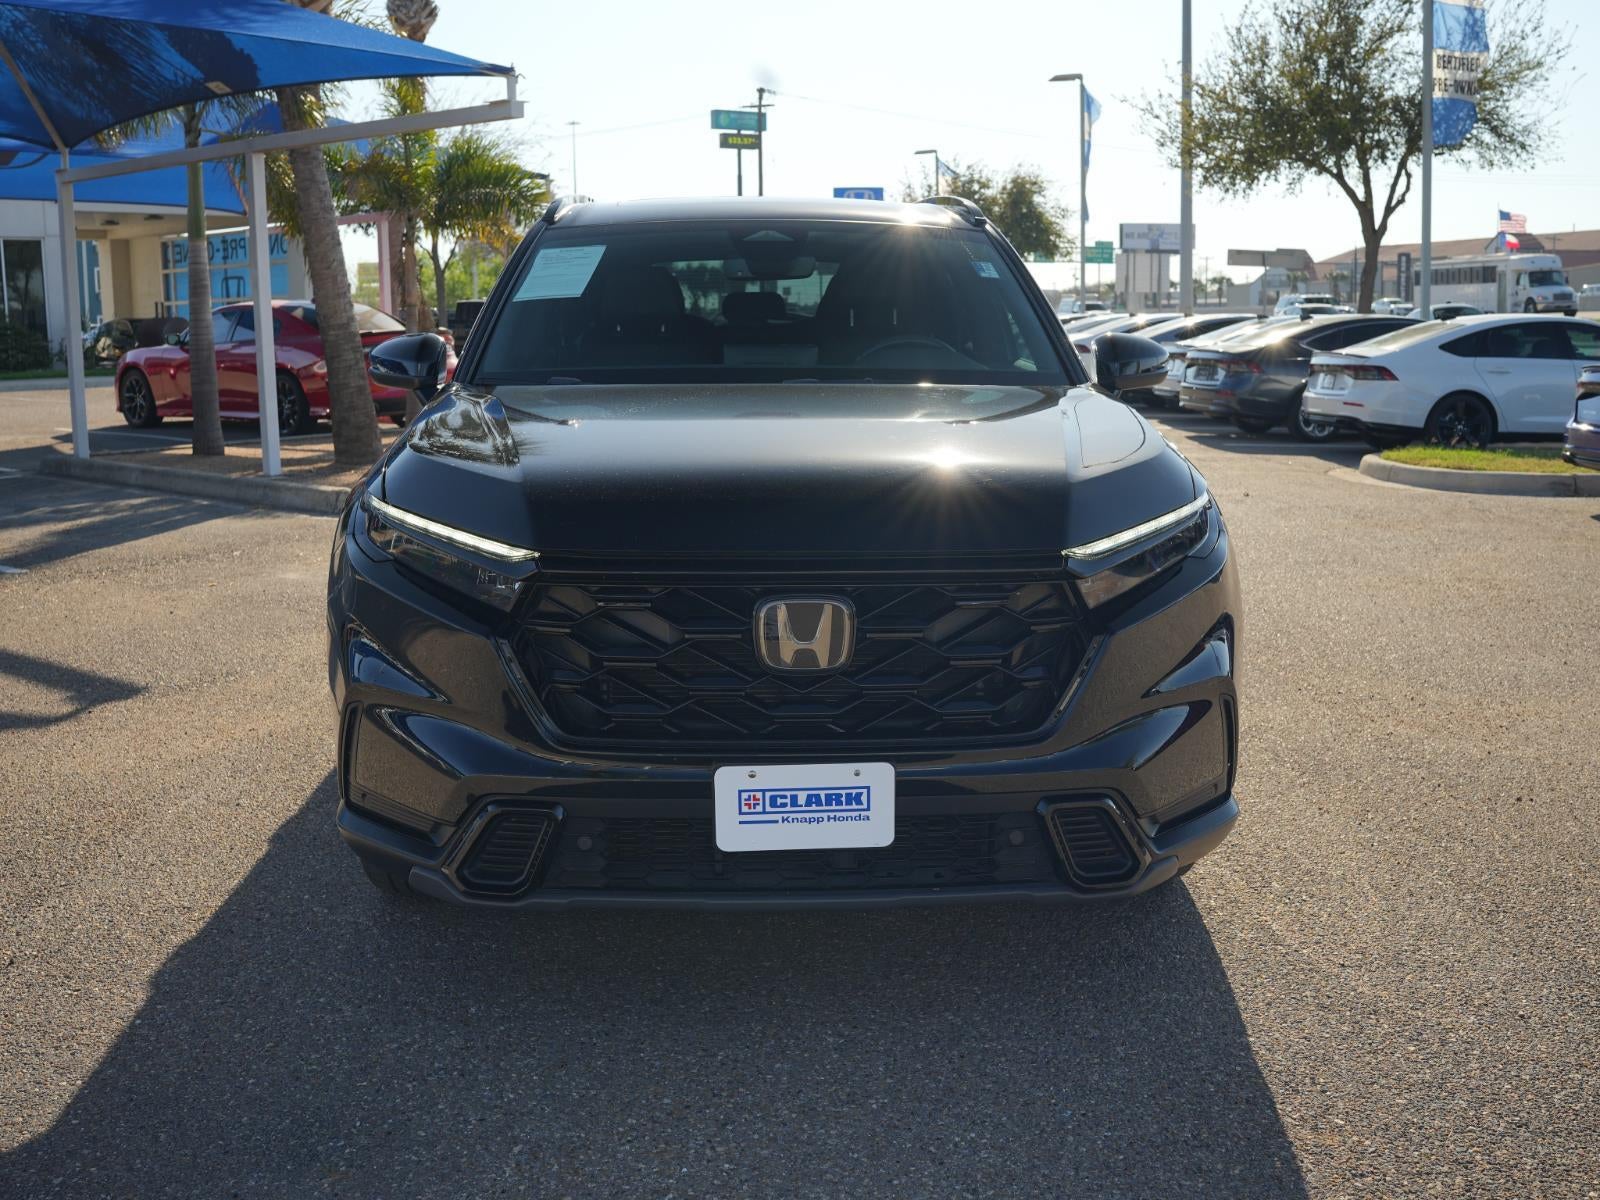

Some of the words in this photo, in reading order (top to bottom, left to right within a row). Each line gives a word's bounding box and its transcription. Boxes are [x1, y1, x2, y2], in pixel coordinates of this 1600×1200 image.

[1432, 77, 1480, 96] PRE-OWN
[769, 791, 864, 809] CLARK
[781, 815, 824, 825] Knapp
[827, 813, 870, 823] Honda
